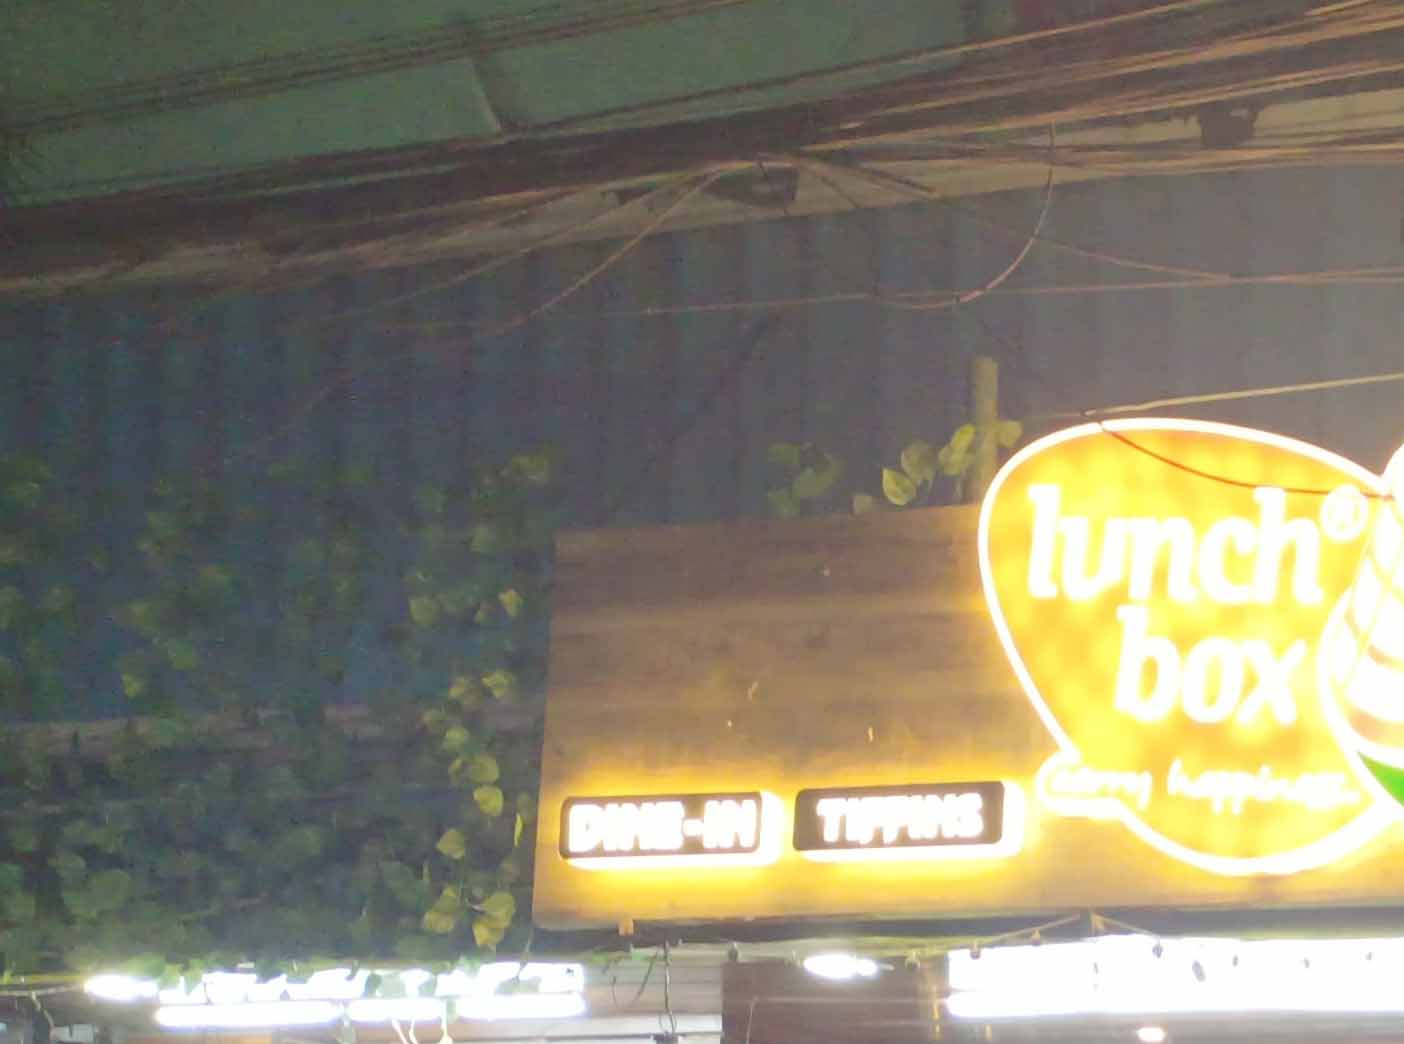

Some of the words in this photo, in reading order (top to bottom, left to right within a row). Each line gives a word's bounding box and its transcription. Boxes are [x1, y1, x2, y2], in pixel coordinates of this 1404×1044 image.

[1027, 483, 1324, 606] lunch
[1112, 603, 1308, 727] box
[568, 800, 759, 853] DINE-IN
[815, 793, 984, 844] TIFFINS
